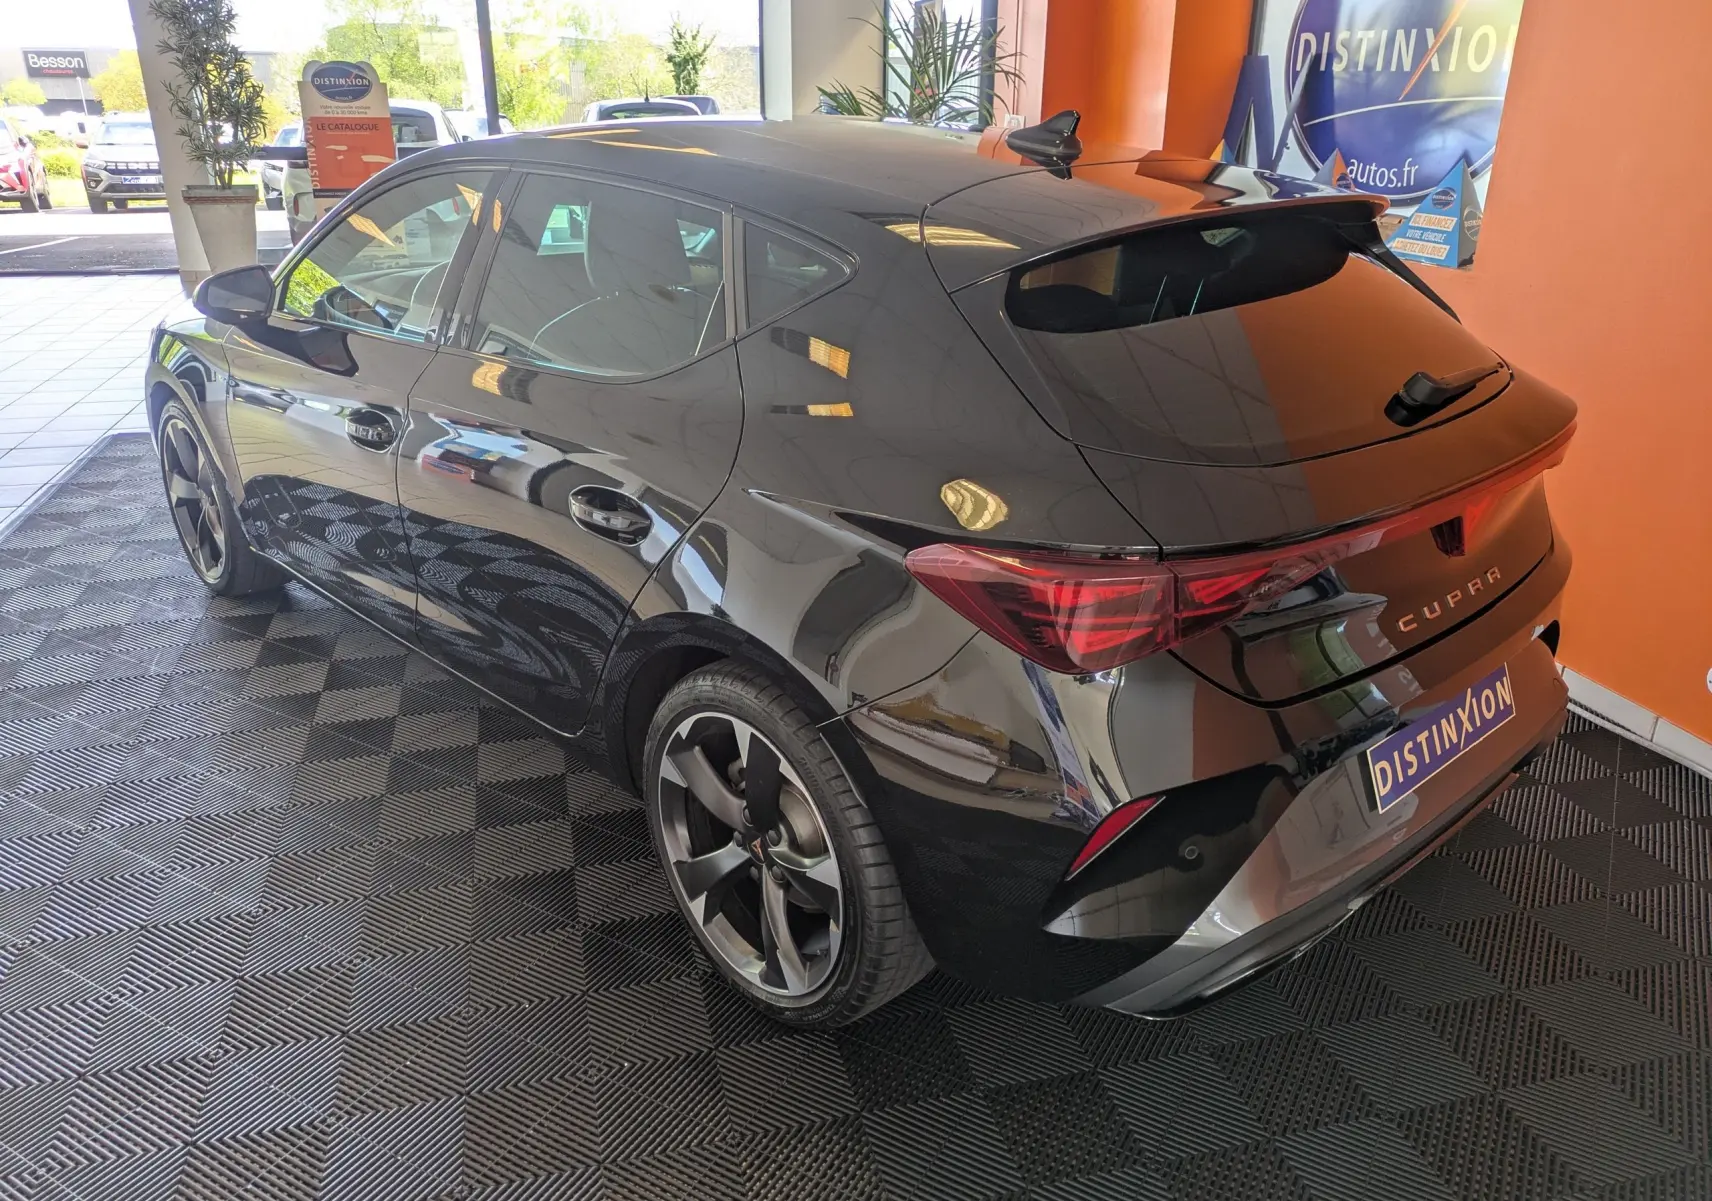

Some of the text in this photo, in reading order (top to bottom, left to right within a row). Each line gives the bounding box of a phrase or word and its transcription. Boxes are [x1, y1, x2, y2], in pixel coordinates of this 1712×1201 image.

[27, 53, 84, 68] Besson
[314, 76, 369, 86] DISTINXION
[316, 123, 380, 131] LE CATALOGUE
[1347, 157, 1419, 188] autos.fr
[1397, 566, 1501, 632] CUPRA
[1374, 676, 1511, 797] DISTINXION
